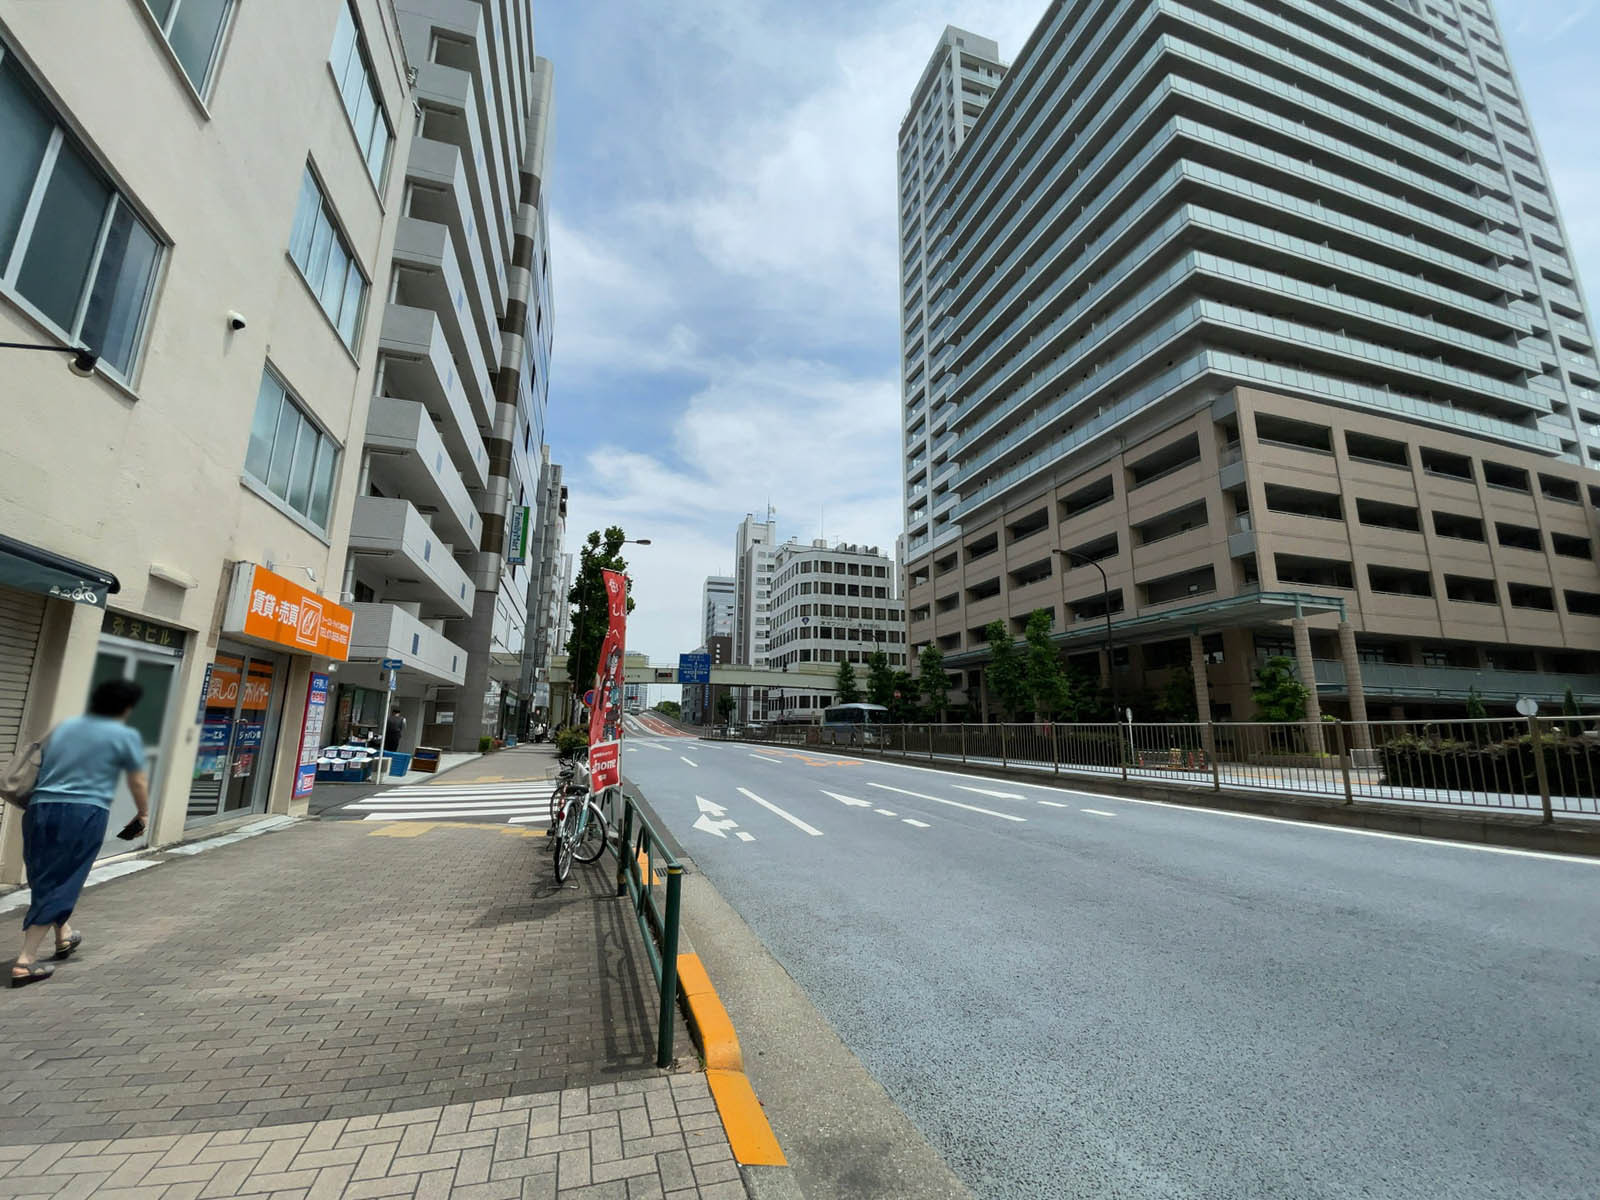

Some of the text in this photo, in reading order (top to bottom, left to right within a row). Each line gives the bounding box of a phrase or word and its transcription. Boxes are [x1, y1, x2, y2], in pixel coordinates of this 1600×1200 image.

[512, 511, 523, 551] FamilyMart
[251, 589, 300, 627] 賃貸・売買
